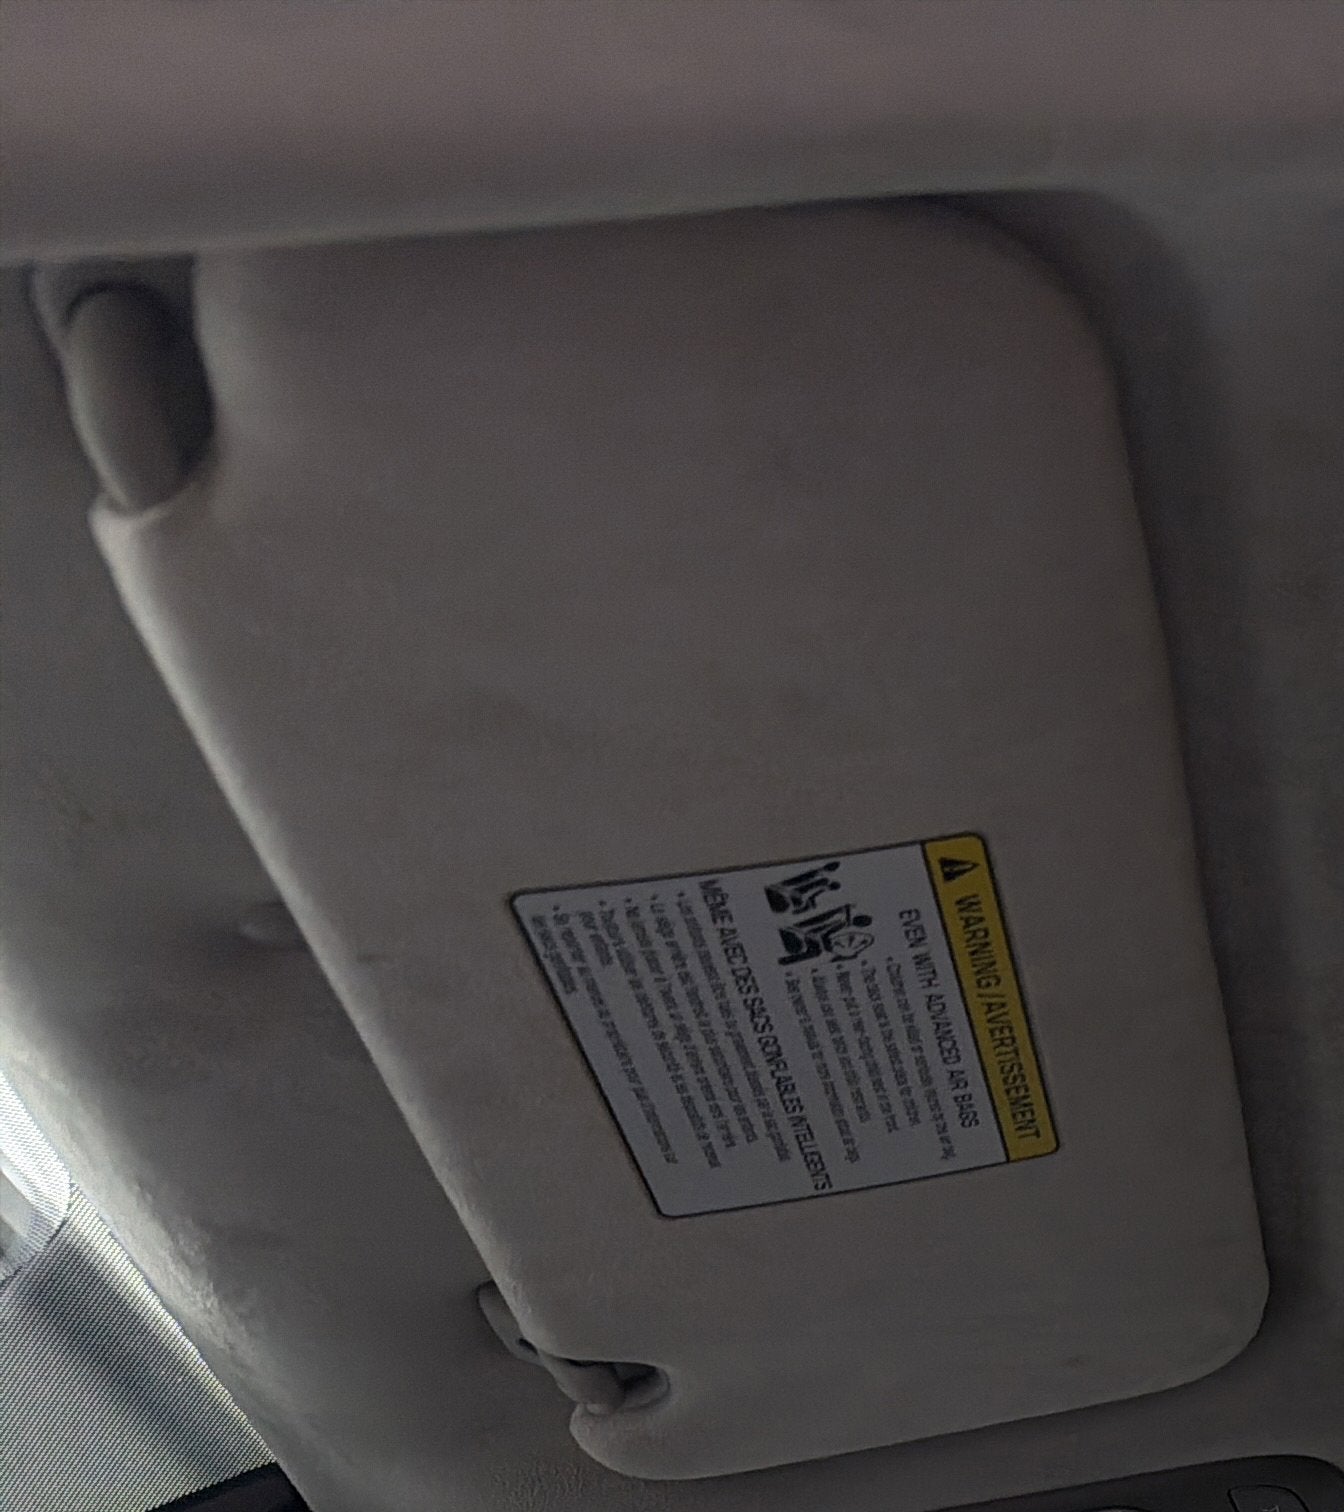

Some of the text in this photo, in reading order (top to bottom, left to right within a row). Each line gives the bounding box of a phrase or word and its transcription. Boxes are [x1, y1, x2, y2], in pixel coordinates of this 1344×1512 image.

[716, 927, 749, 966] AVEC
[954, 893, 1002, 990] WARNING
[730, 966, 760, 995] DES
[742, 996, 774, 1034] SACS
[898, 908, 980, 1129] EVEN WITH ADVANCED AIR BAGS
